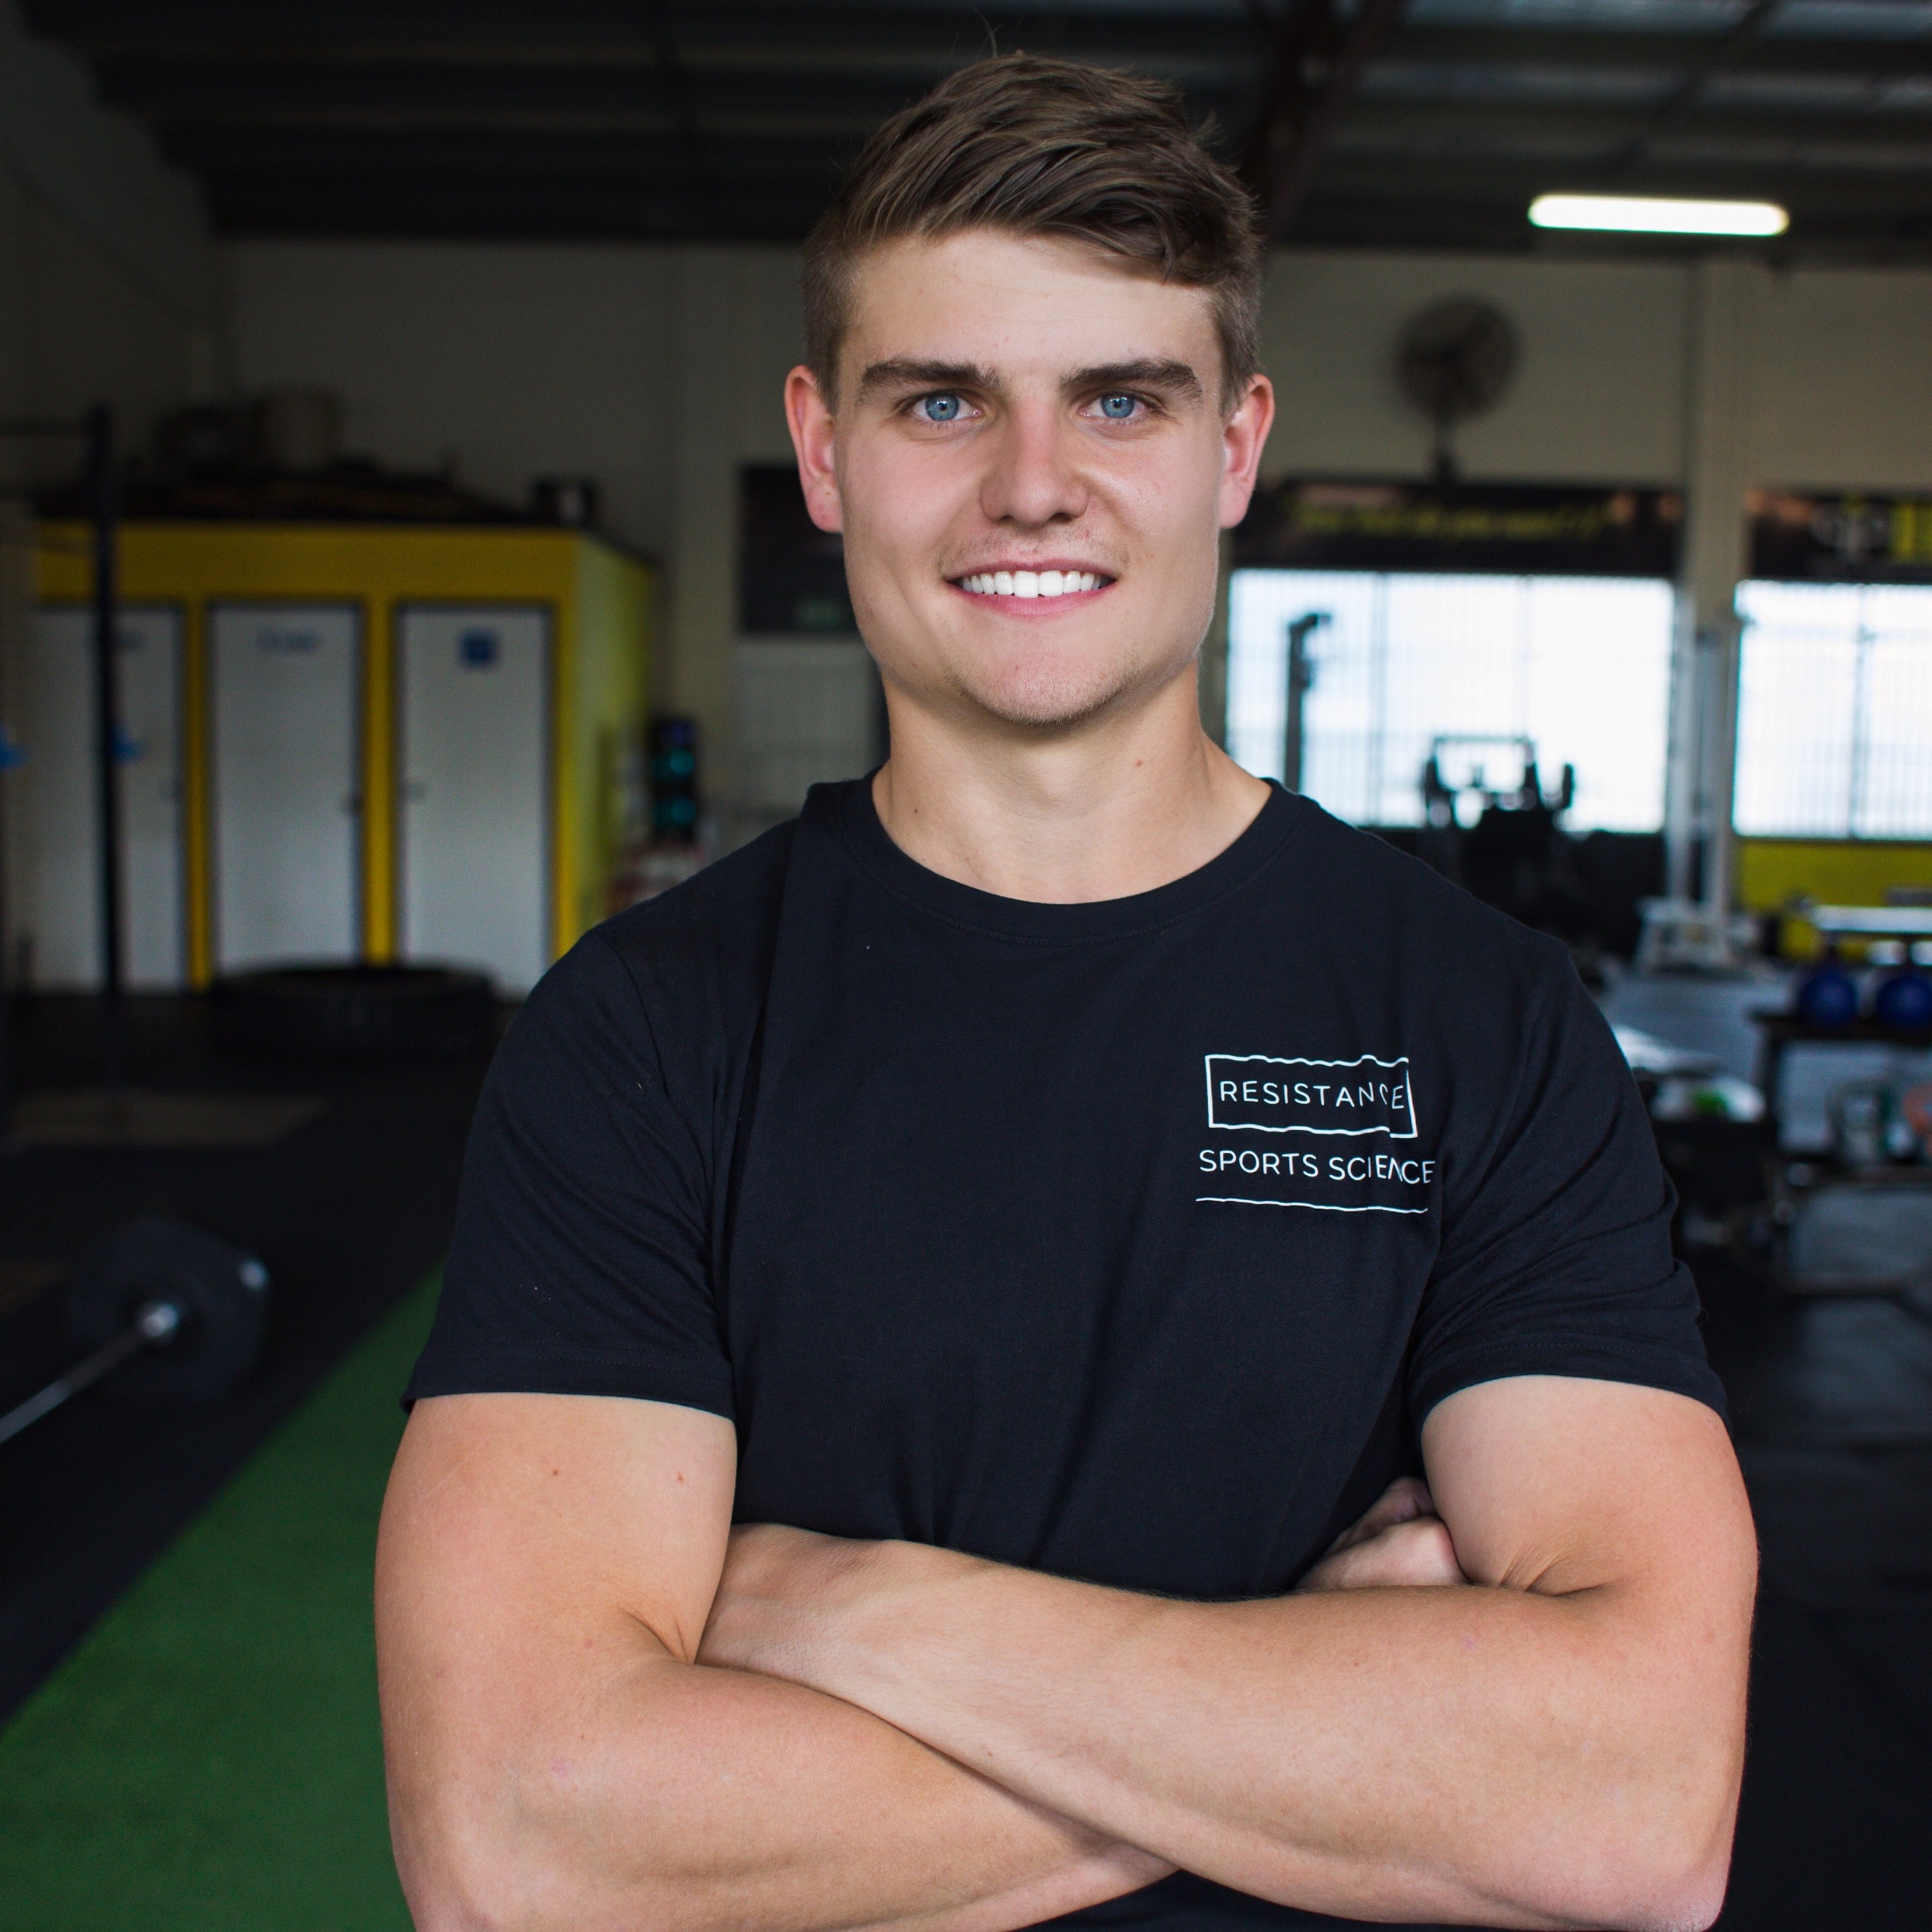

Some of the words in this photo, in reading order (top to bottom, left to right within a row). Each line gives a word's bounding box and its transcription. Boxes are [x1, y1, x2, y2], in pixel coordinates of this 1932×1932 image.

[1220, 1080, 1405, 1110] RESISTANCE
[1199, 1150, 1319, 1177] SPORTS
[1329, 1154, 1435, 1184] SCIENCE
